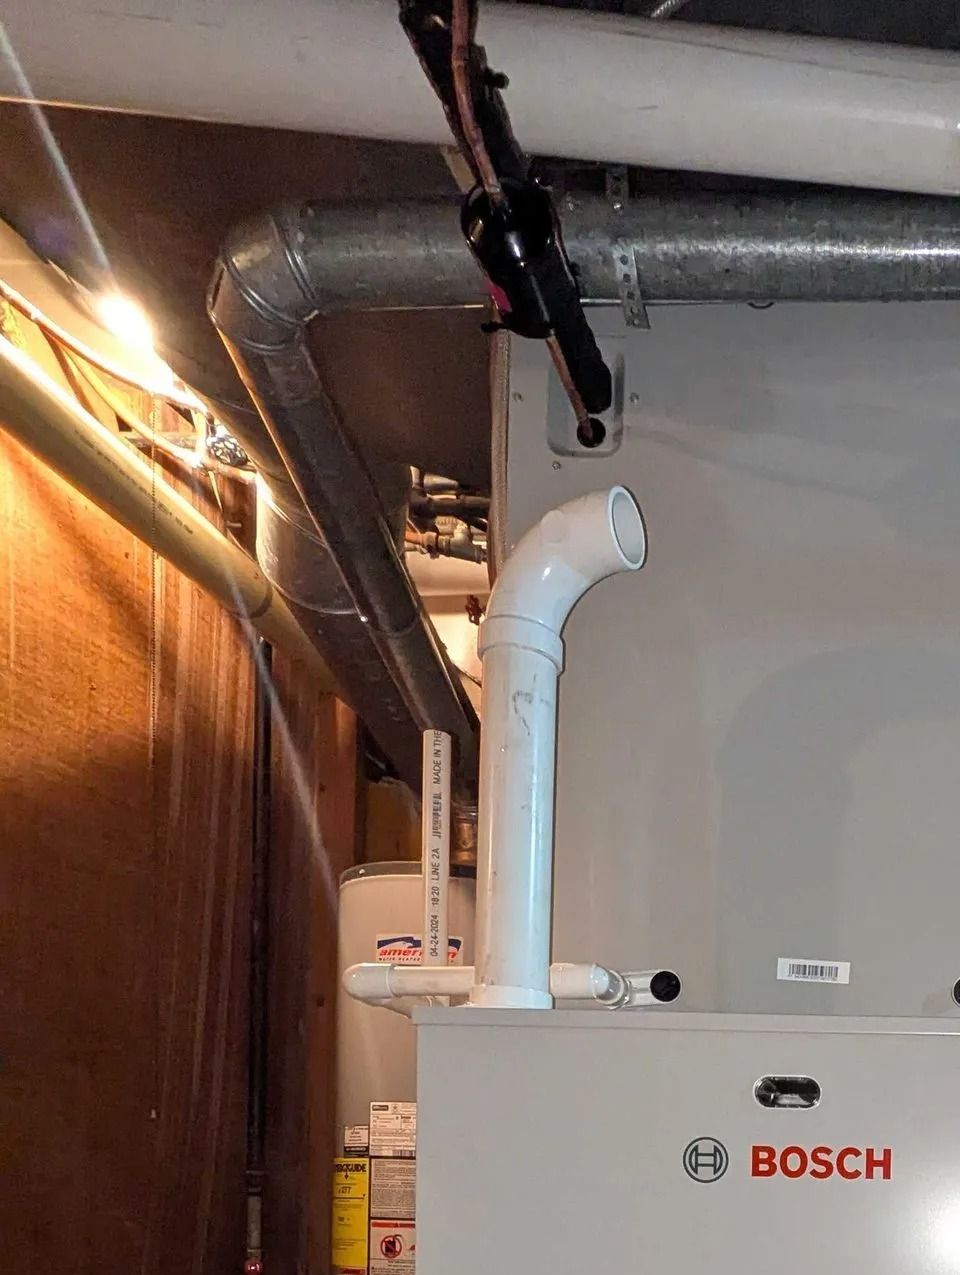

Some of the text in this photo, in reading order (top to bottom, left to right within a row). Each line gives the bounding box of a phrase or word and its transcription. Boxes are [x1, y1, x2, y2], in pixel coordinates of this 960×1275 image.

[433, 730, 442, 748] THE
[433, 749, 442, 758] IN
[432, 760, 442, 785] MADE
[431, 848, 440, 859] 2A
[431, 862, 441, 881] LINE
[430, 914, 439, 957] 04-24-2024
[751, 1145, 892, 1180] BOSCH
